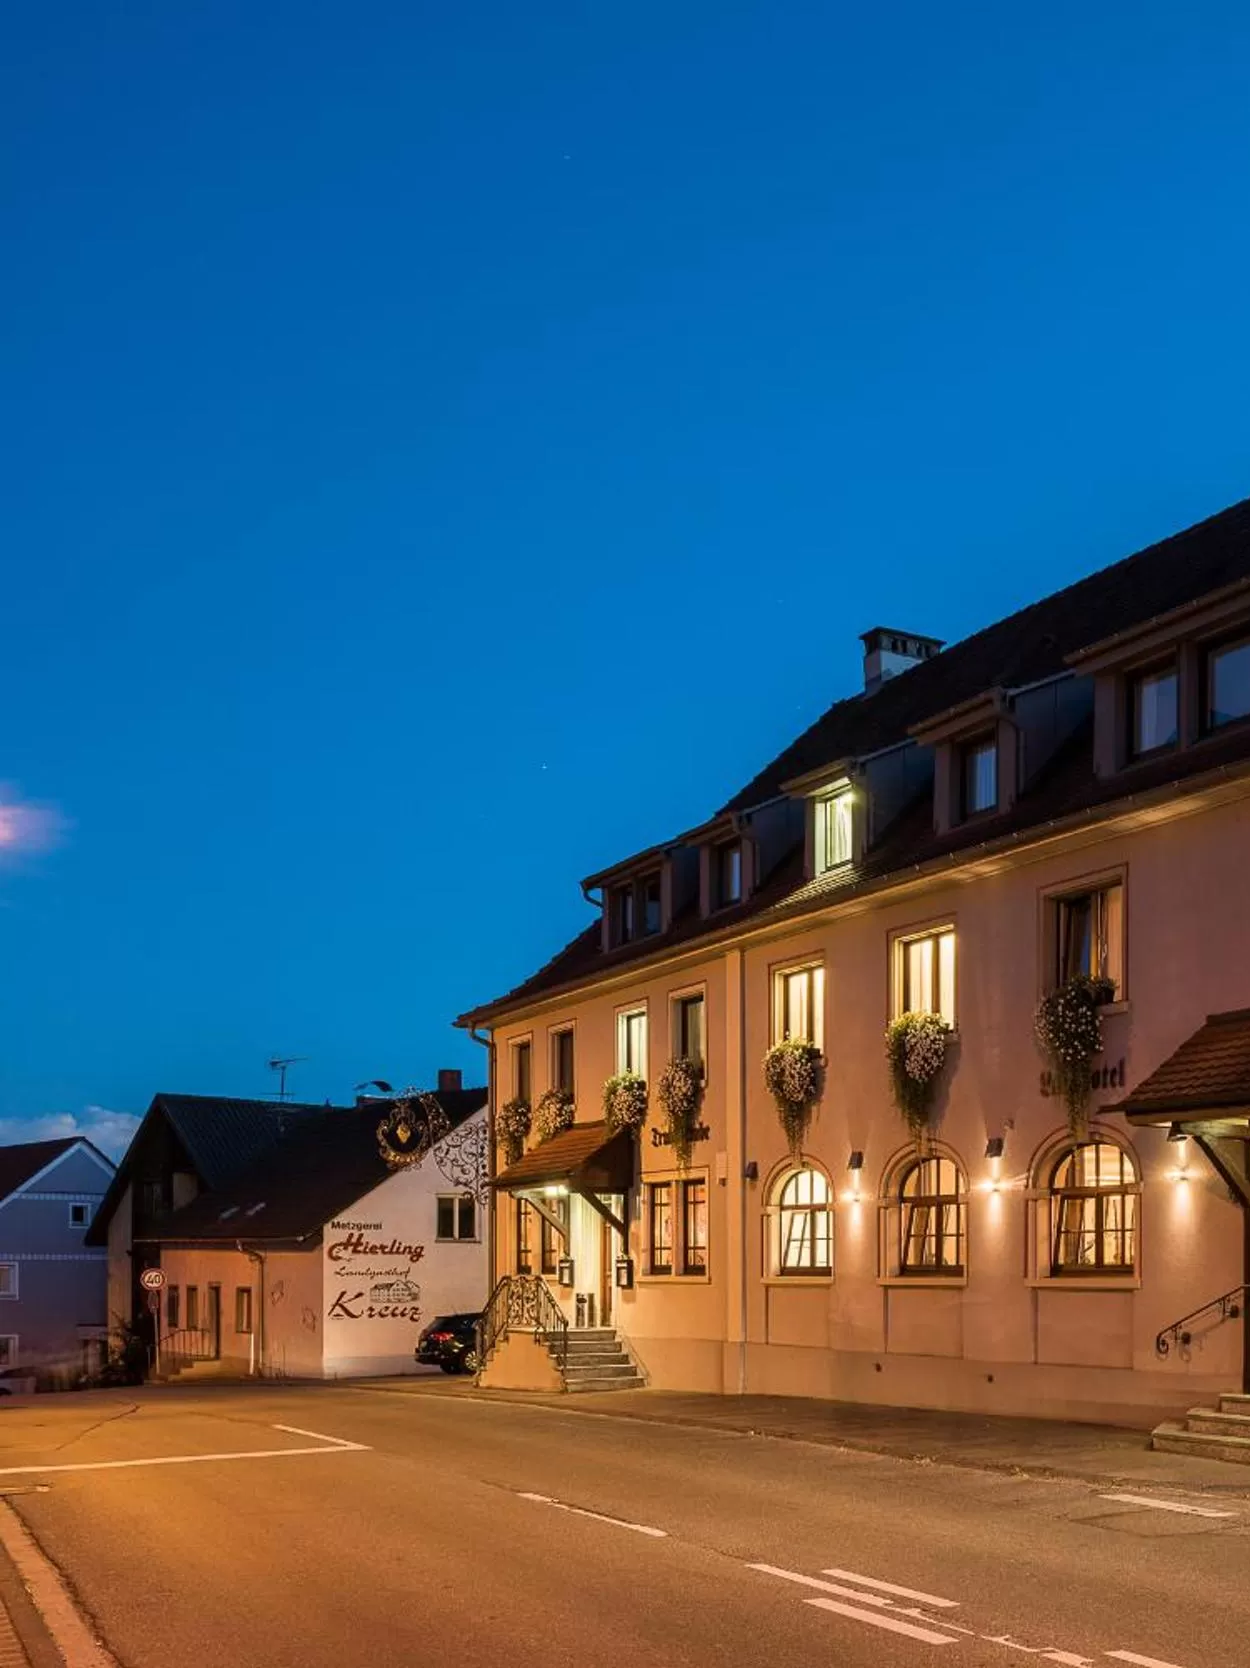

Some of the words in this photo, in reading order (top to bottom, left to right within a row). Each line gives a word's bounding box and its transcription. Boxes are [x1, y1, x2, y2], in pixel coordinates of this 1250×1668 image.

[331, 1221, 383, 1232] Metzgerei
[327, 1232, 425, 1263] Hierling
[146, 1274, 161, 1285] 40
[327, 1290, 422, 1322] Kreuz
